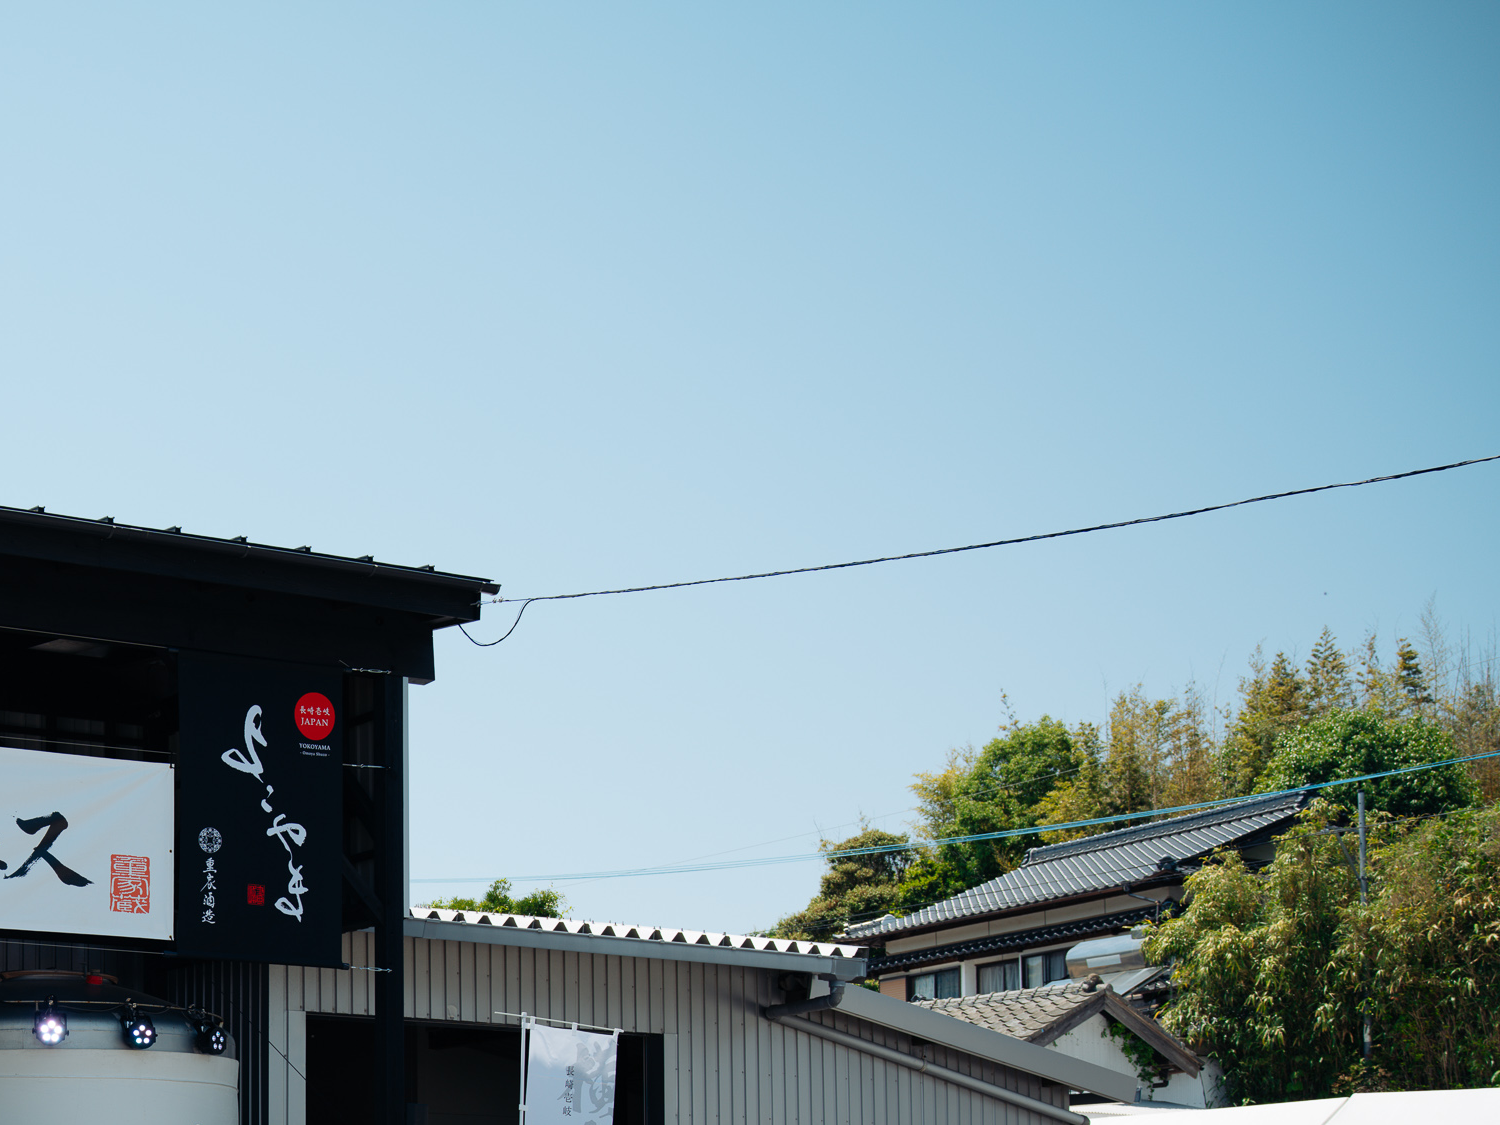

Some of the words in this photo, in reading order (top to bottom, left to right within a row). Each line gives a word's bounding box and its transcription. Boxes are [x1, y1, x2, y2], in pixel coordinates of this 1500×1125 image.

[301, 717, 329, 726] JAPAN
[299, 743, 331, 751] YOKOYAMA
[200, 857, 218, 924] 重家酒造
